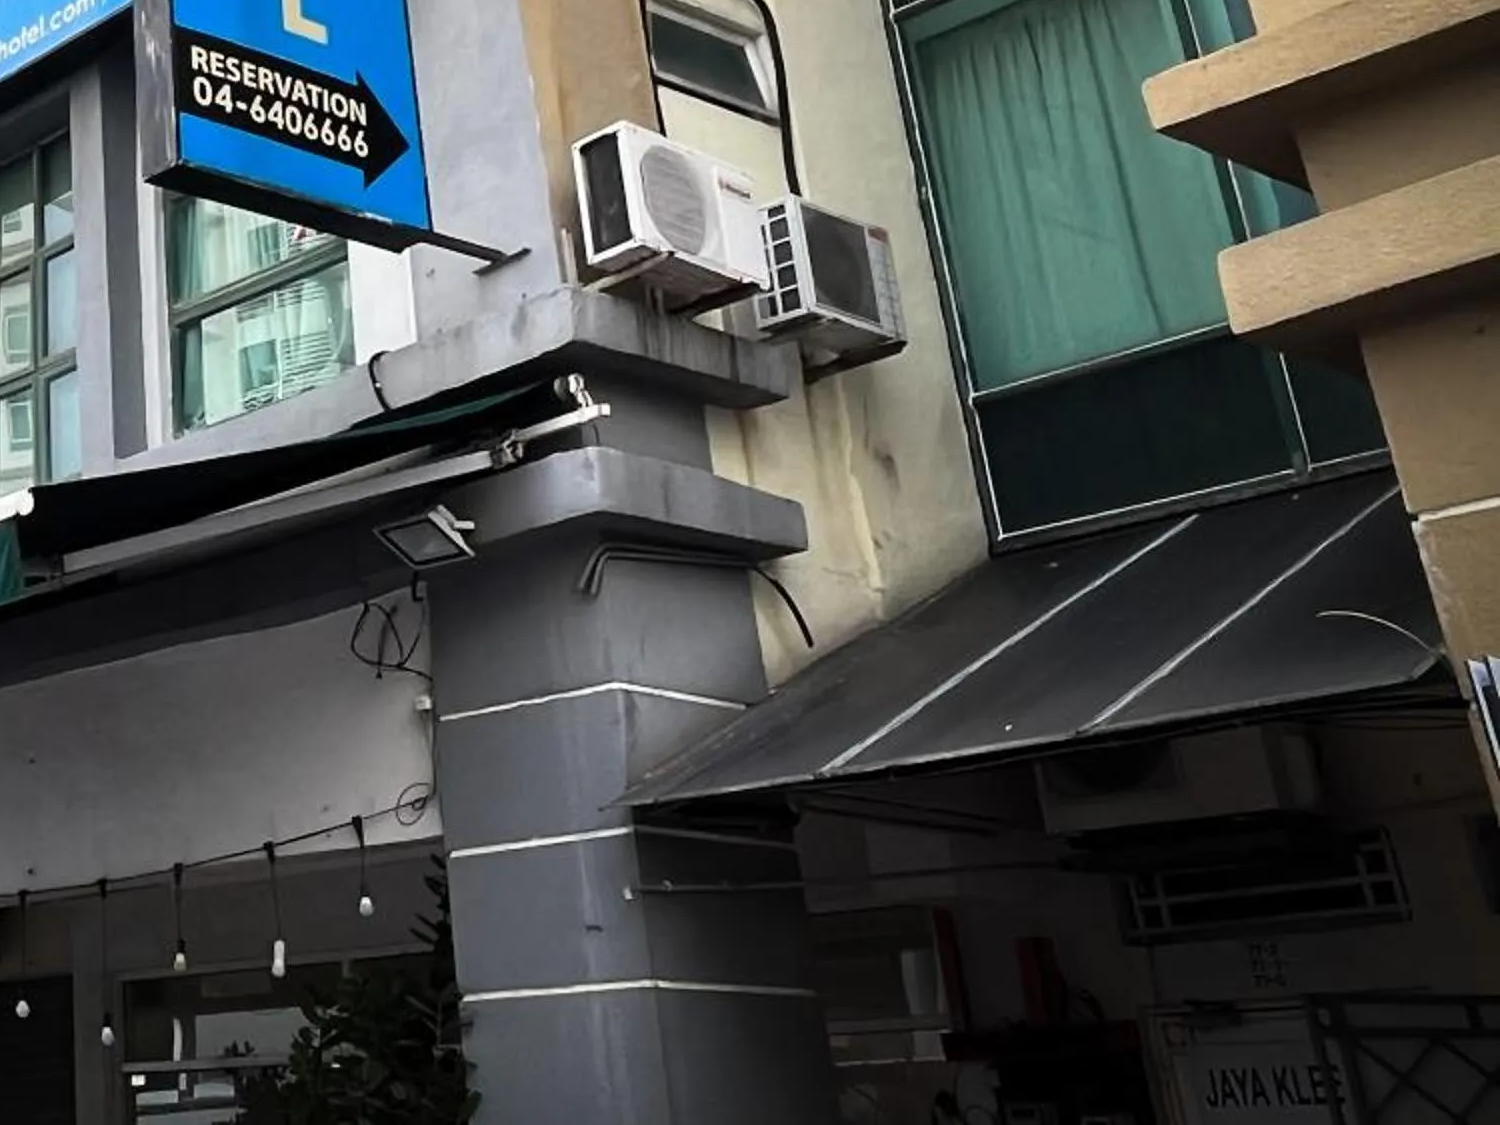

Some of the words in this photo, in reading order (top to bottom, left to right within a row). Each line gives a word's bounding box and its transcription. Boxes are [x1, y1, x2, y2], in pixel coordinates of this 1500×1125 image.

[191, 45, 367, 126] RESERVATION
[193, 77, 369, 157] 04-6406666
[1206, 1066, 1271, 1107] JAYA
